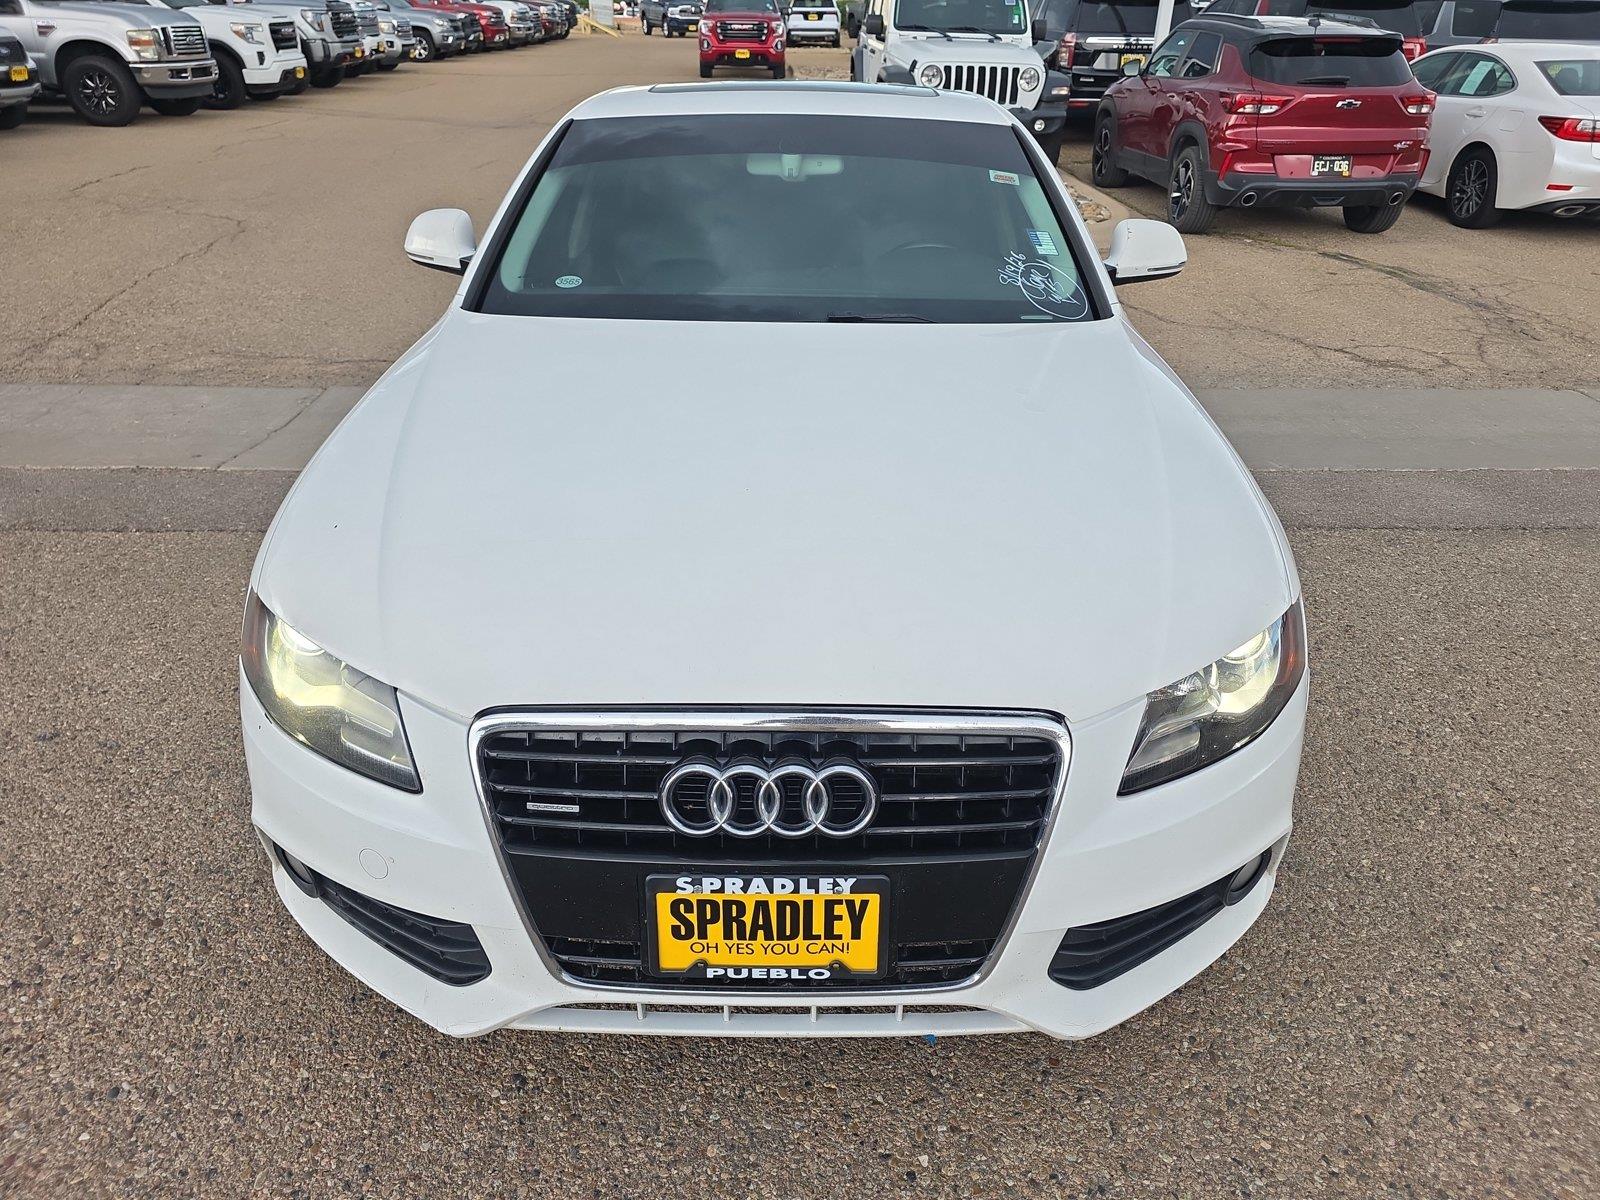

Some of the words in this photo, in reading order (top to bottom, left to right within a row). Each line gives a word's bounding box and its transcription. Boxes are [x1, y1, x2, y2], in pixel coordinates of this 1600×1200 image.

[531, 803, 575, 811] quattro
[675, 877, 858, 894] SPRADLEY
[669, 898, 870, 942] SPRADLEY
[690, 942, 719, 954] OH
[725, 942, 755, 955] YES
[760, 943, 799, 955] YOU
[806, 942, 850, 955] CAN!
[706, 968, 831, 980] PUEBLO
